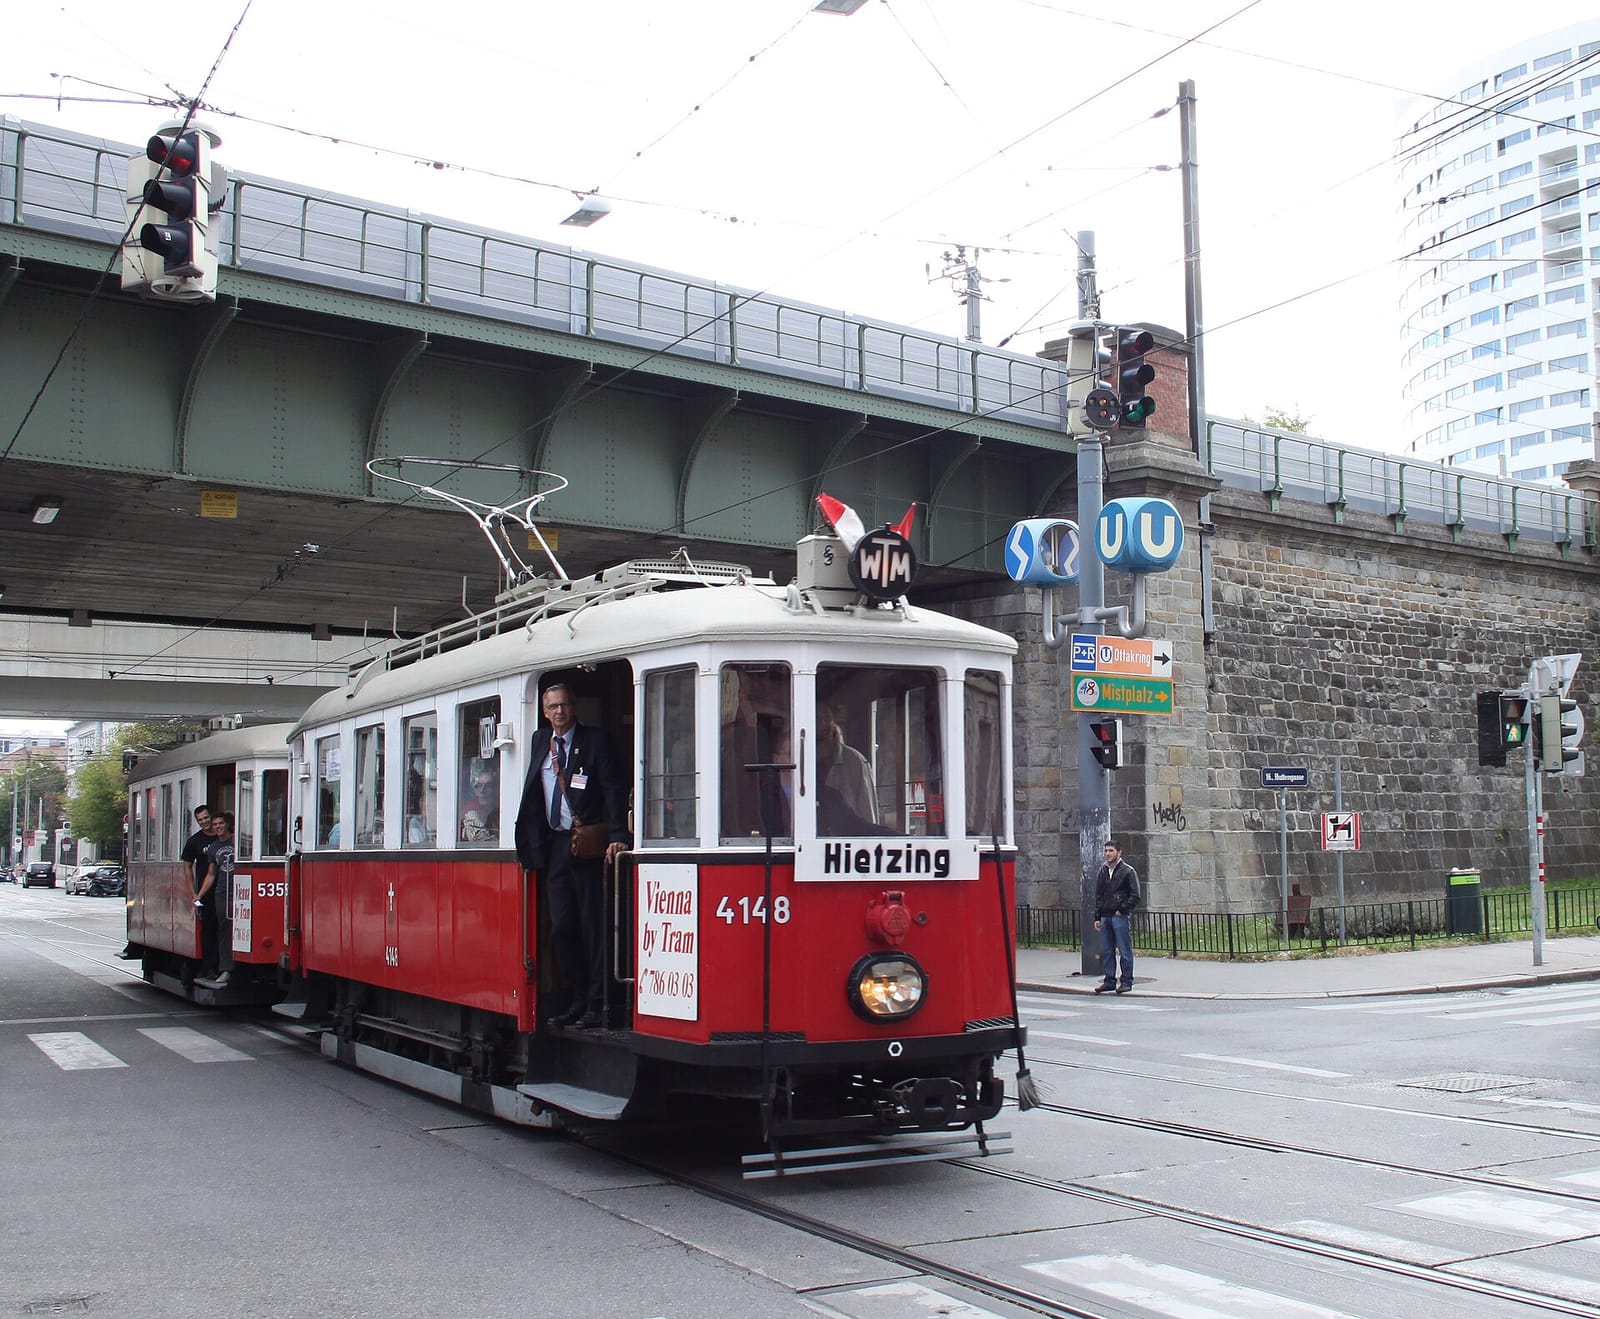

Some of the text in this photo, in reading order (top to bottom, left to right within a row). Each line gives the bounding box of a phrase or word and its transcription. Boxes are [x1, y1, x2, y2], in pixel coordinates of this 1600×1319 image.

[1101, 512, 1124, 559] U
[1140, 512, 1175, 559] U
[1073, 646, 1096, 660] P+R
[1114, 647, 1151, 667] Ottakring
[1080, 681, 1153, 706] 48 Mistplatz
[824, 843, 950, 878] Hietzing
[646, 880, 692, 915] Vienna
[715, 895, 791, 925] 4148
[643, 922, 694, 957] by Tram
[649, 970, 694, 998] 786 03 03
